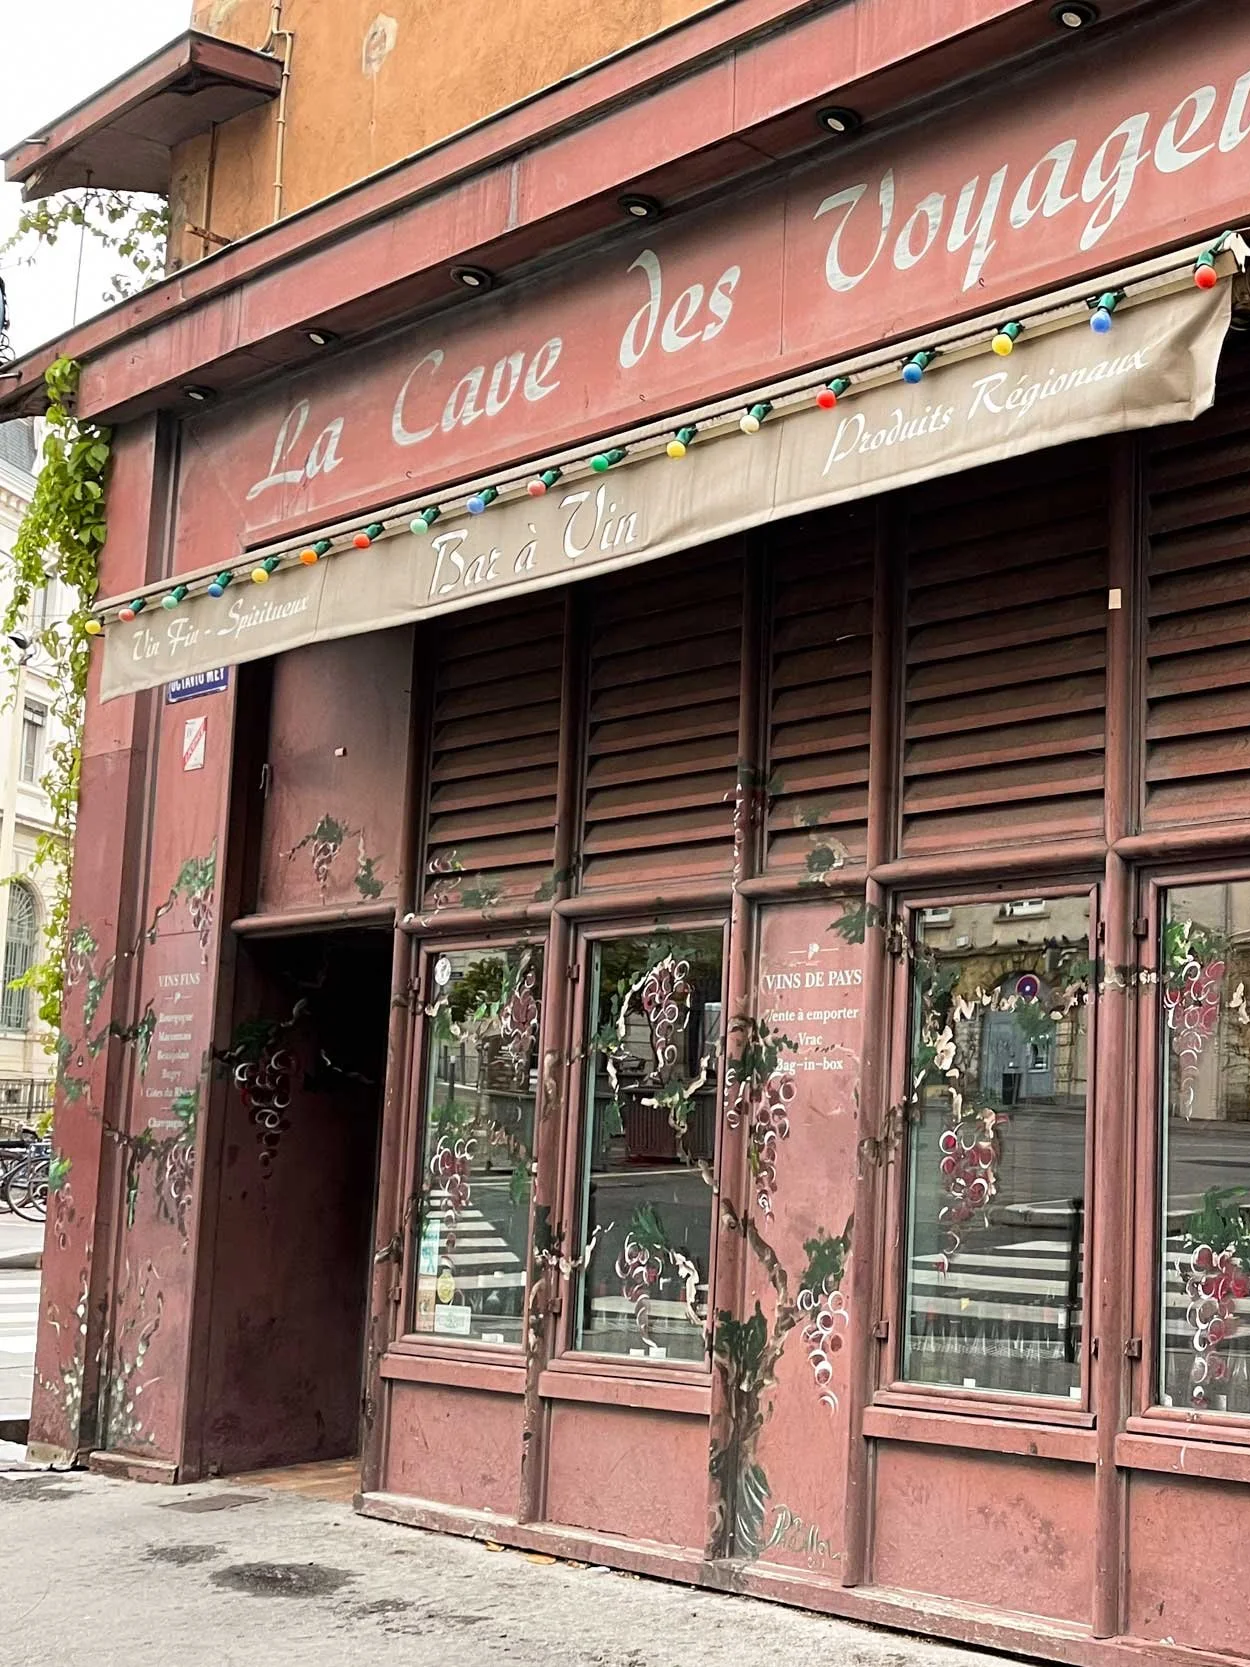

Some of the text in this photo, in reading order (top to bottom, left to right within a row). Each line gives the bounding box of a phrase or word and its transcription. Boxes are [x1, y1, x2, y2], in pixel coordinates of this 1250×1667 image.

[246, 398, 344, 500] La
[390, 336, 562, 446] Cave
[619, 249, 741, 369] des
[822, 345, 1150, 476] Produits Régionaux
[428, 483, 638, 600] Bar à Vin
[132, 630, 160, 661] Vin
[167, 617, 198, 656] Fin
[159, 972, 201, 987] VINS FINS
[766, 969, 862, 989] VINS DE PAYS
[797, 1008, 804, 1021] à
[806, 1007, 859, 1024] emporter
[798, 1032, 823, 1045] Vrac
